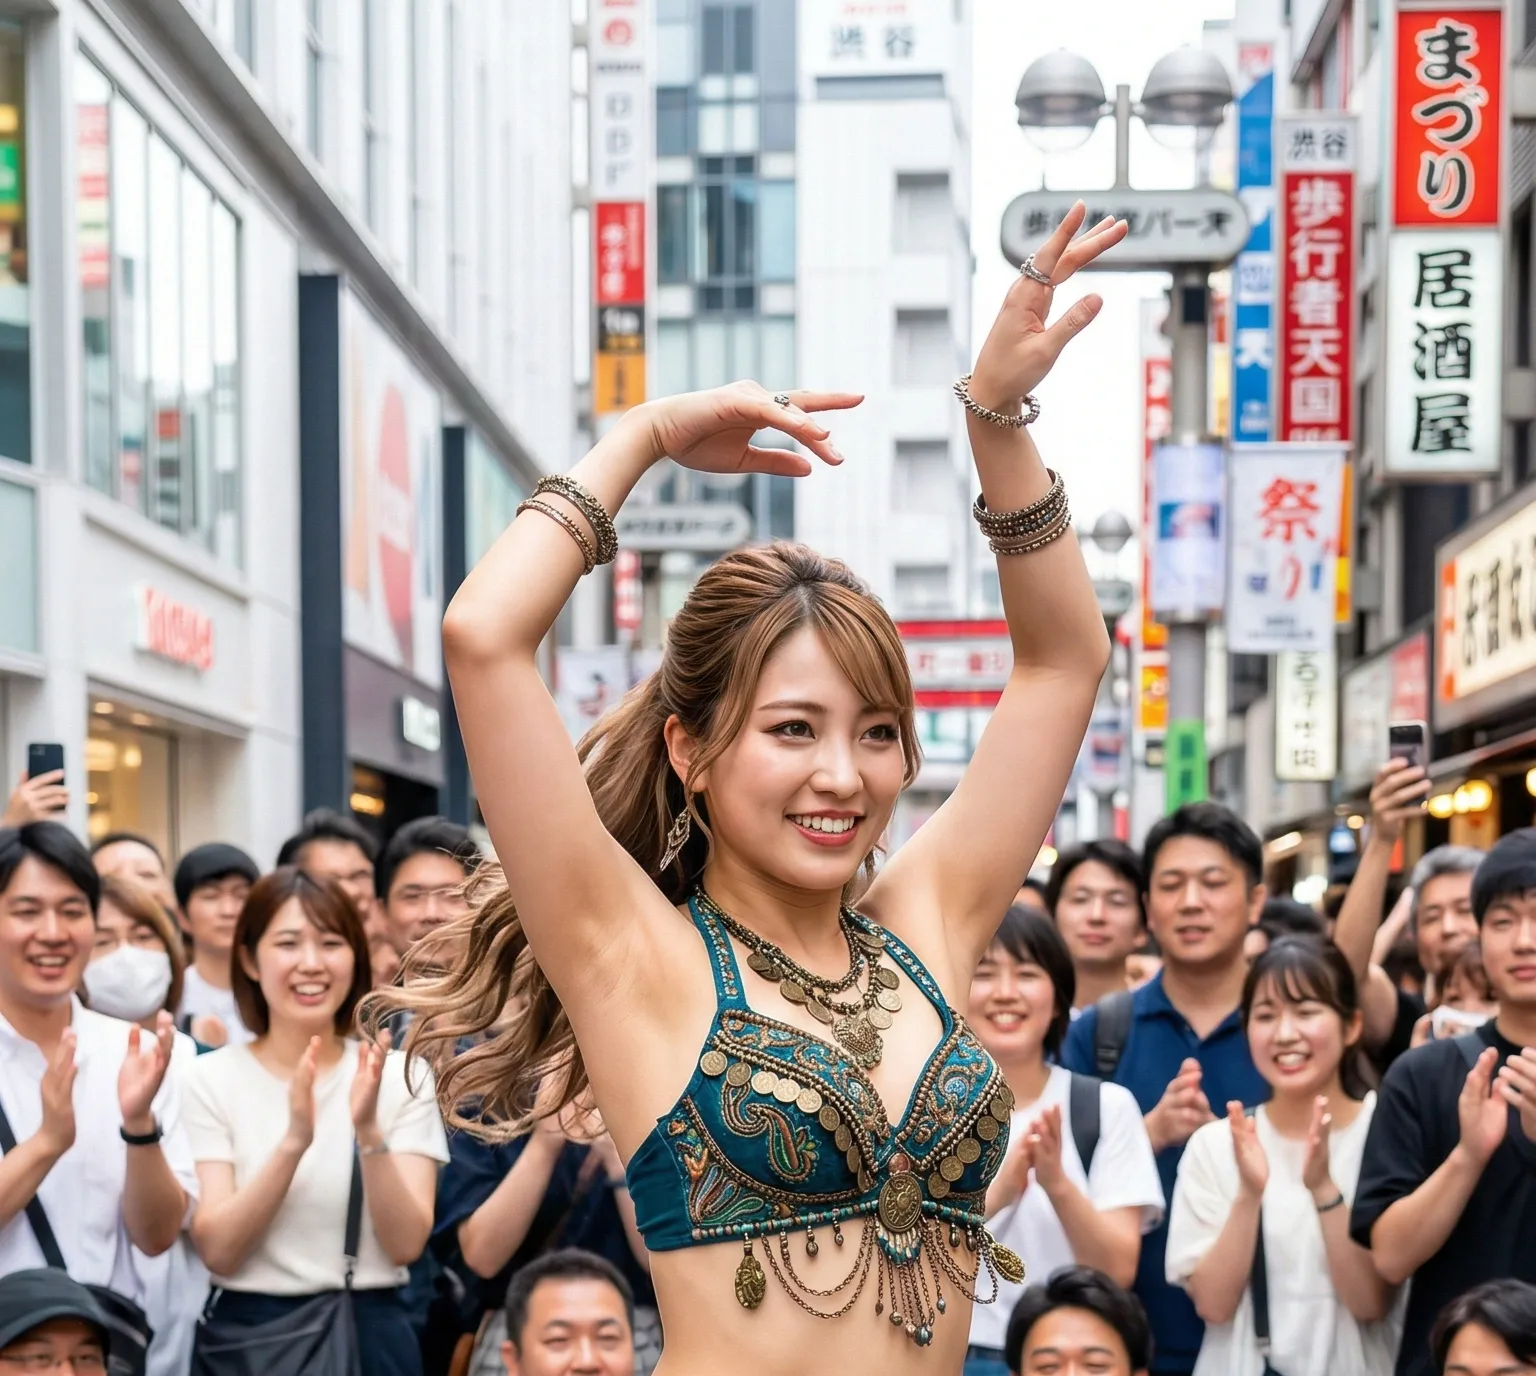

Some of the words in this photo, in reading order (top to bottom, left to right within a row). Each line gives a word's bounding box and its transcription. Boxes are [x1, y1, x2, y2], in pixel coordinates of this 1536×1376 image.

[1289, 176, 1345, 441] 歩行者天国
[1412, 249, 1473, 452] 居酒屋
